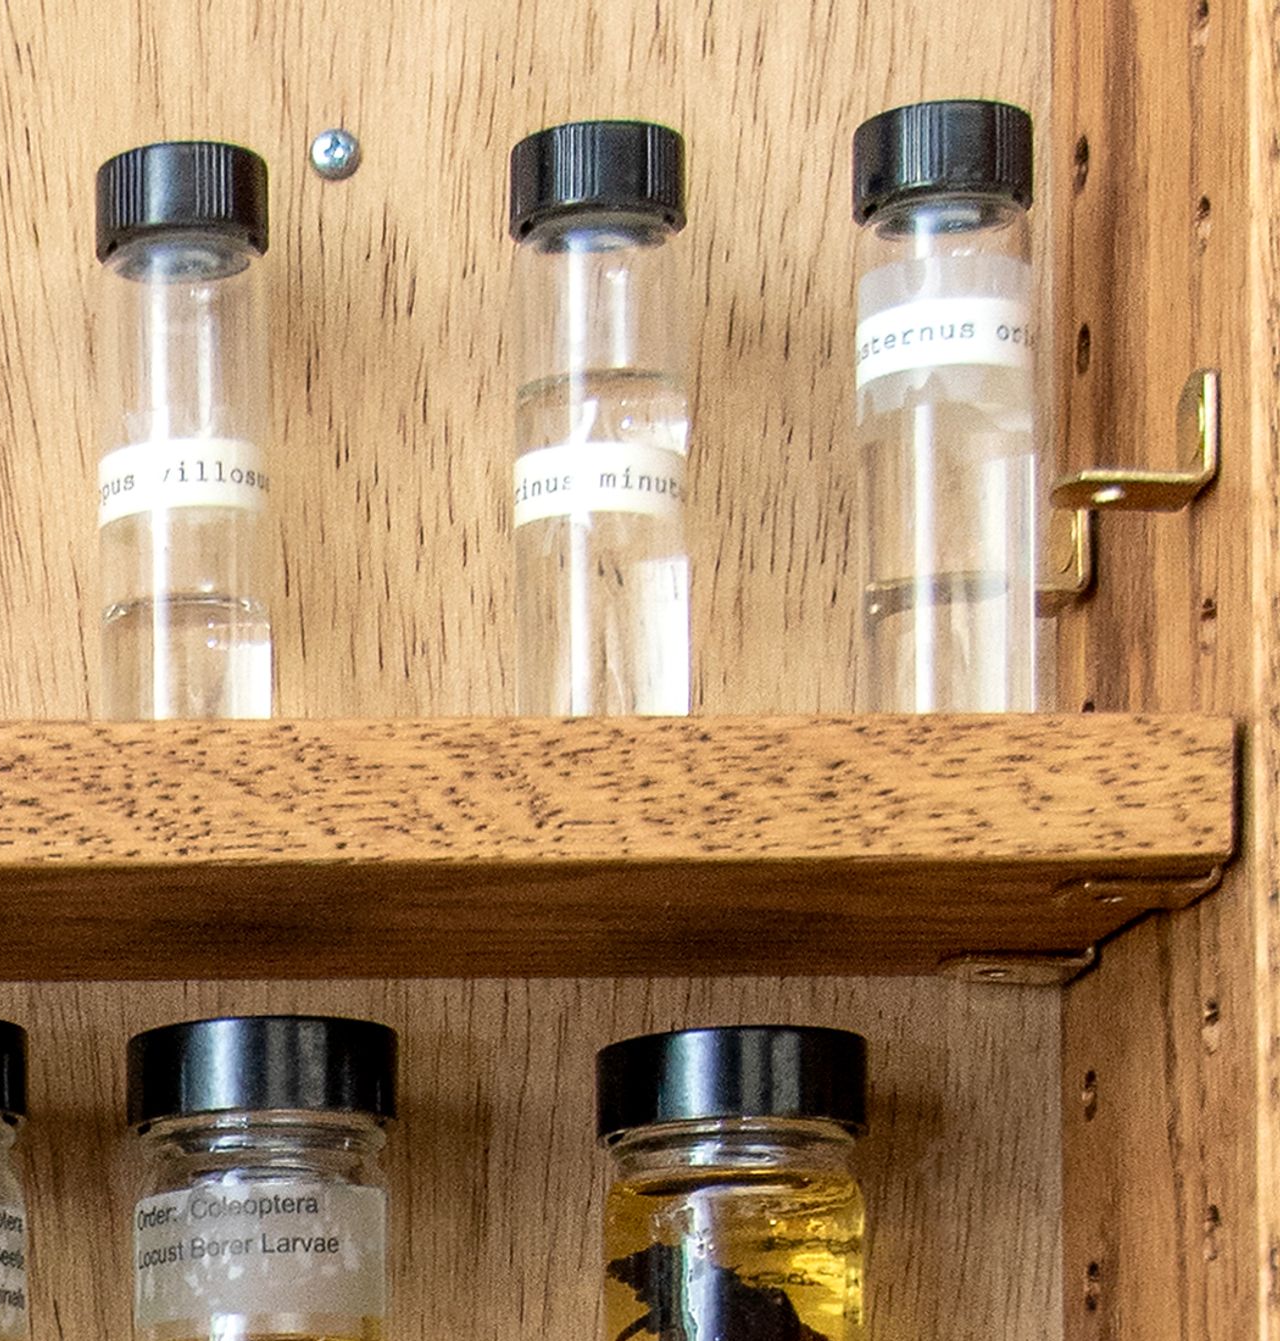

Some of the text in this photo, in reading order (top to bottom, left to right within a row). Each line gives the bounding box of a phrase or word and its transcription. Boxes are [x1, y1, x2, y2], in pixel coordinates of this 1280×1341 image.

[137, 1194, 319, 1231] Order: Coleoptera
[191, 1236, 255, 1260] Borer
[262, 1233, 340, 1255] Larvae
